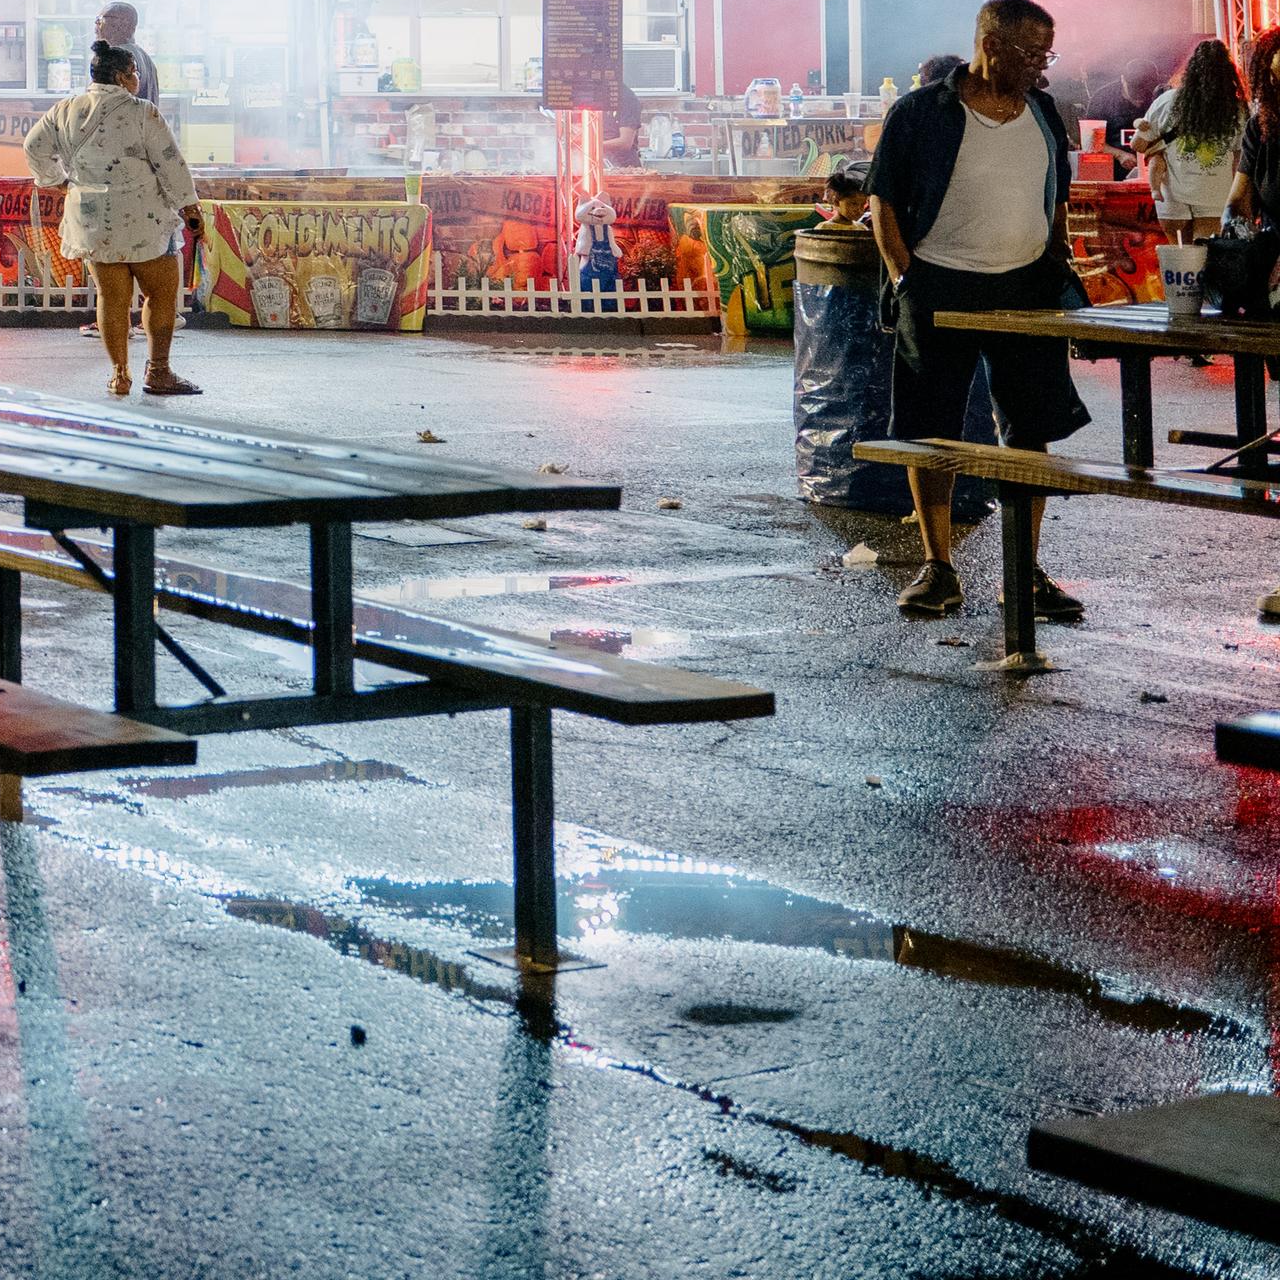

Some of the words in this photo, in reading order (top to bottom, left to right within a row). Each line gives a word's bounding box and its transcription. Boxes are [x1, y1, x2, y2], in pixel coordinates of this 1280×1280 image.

[805, 123, 846, 146] CORN
[0, 190, 57, 217] ROASED
[610, 196, 667, 221] OASTED
[241, 210, 410, 265] CONDIMENTS
